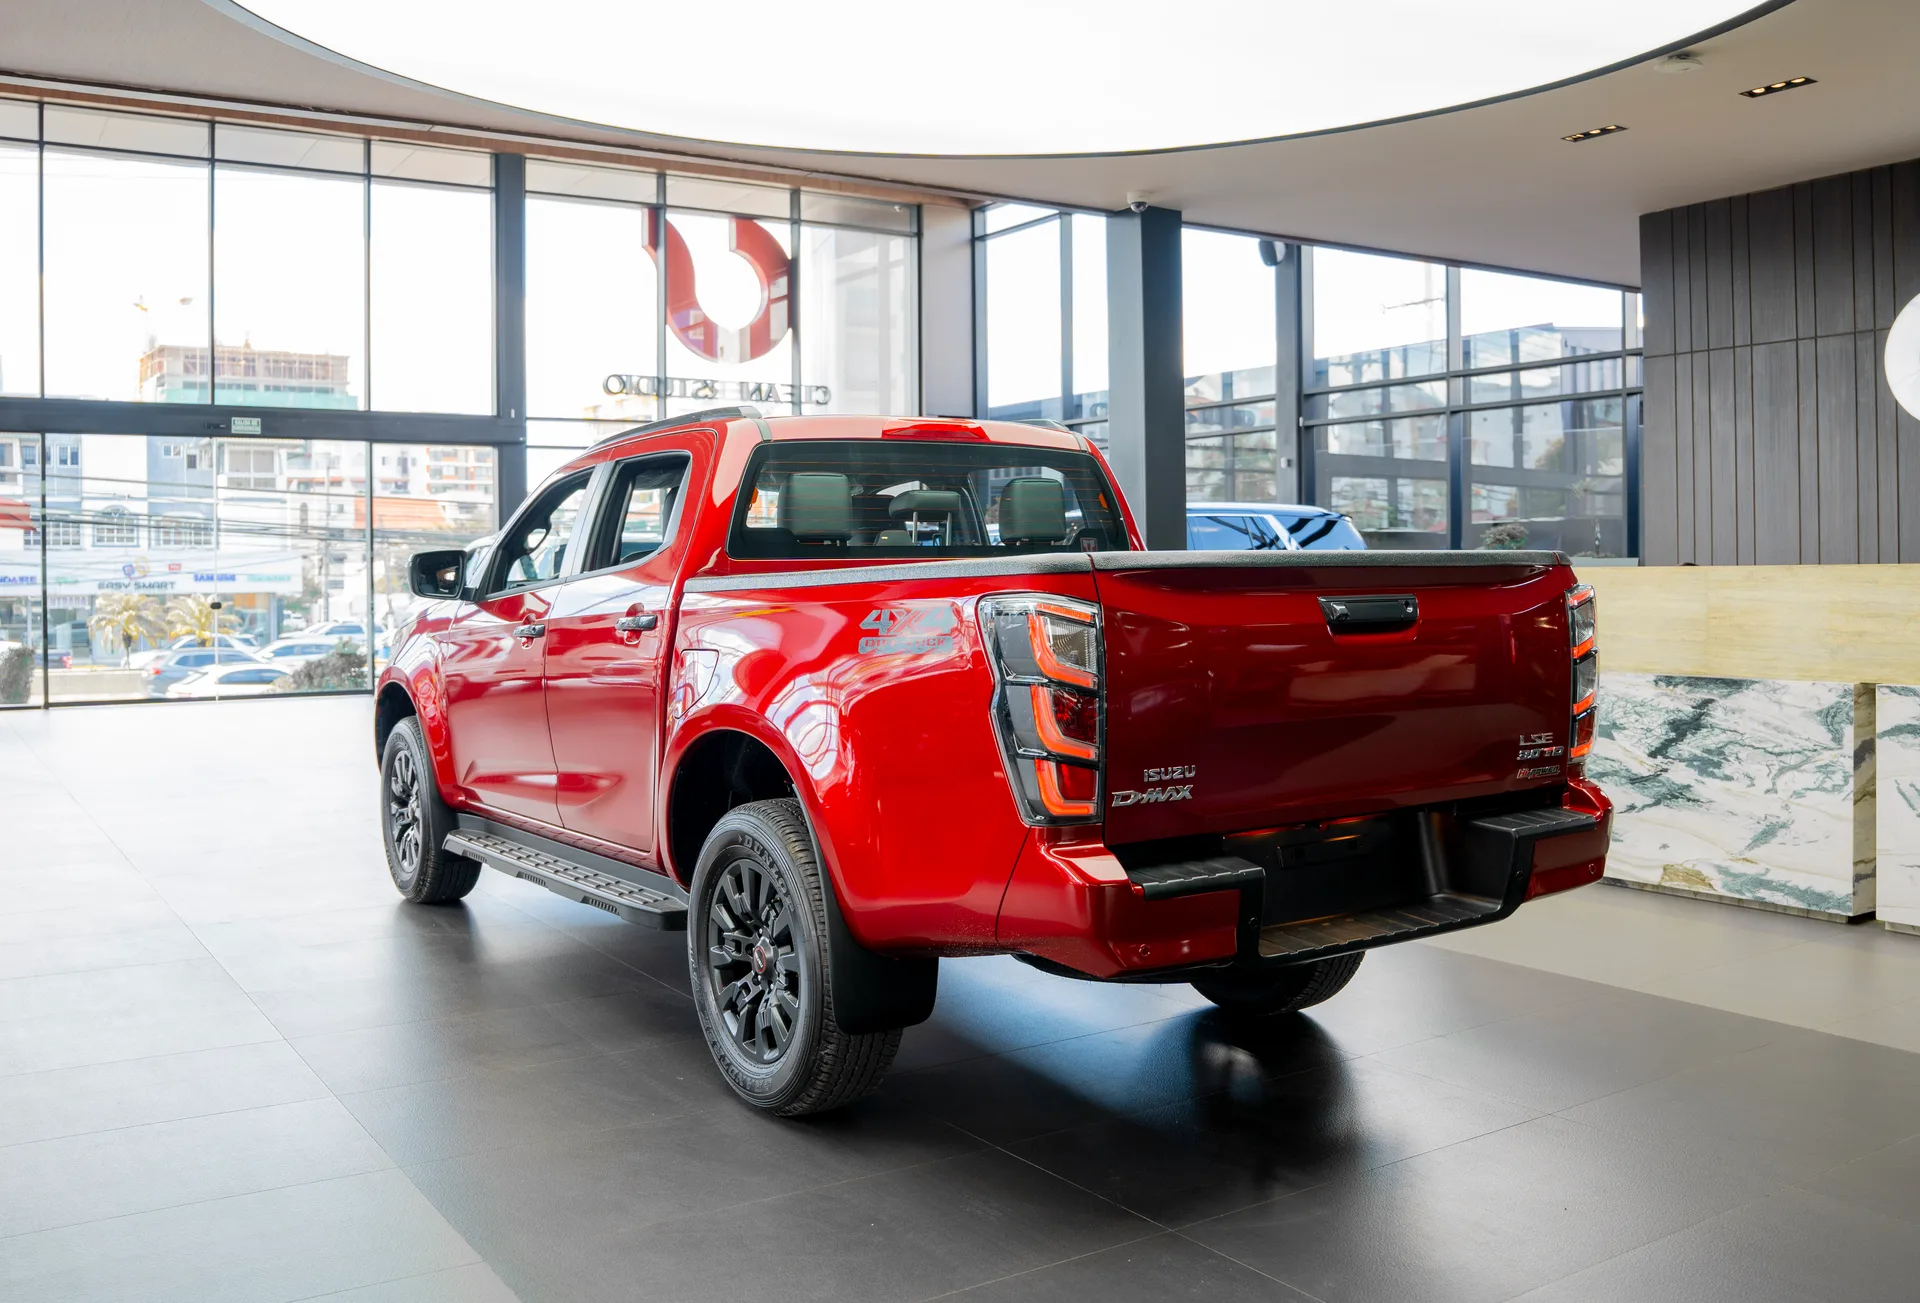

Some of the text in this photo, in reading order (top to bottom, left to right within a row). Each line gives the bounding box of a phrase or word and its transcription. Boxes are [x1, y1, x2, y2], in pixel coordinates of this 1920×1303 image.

[98, 581, 176, 590] EASY SMART
[1519, 732, 1553, 746] LSE
[1143, 765, 1196, 782] ISUZU
